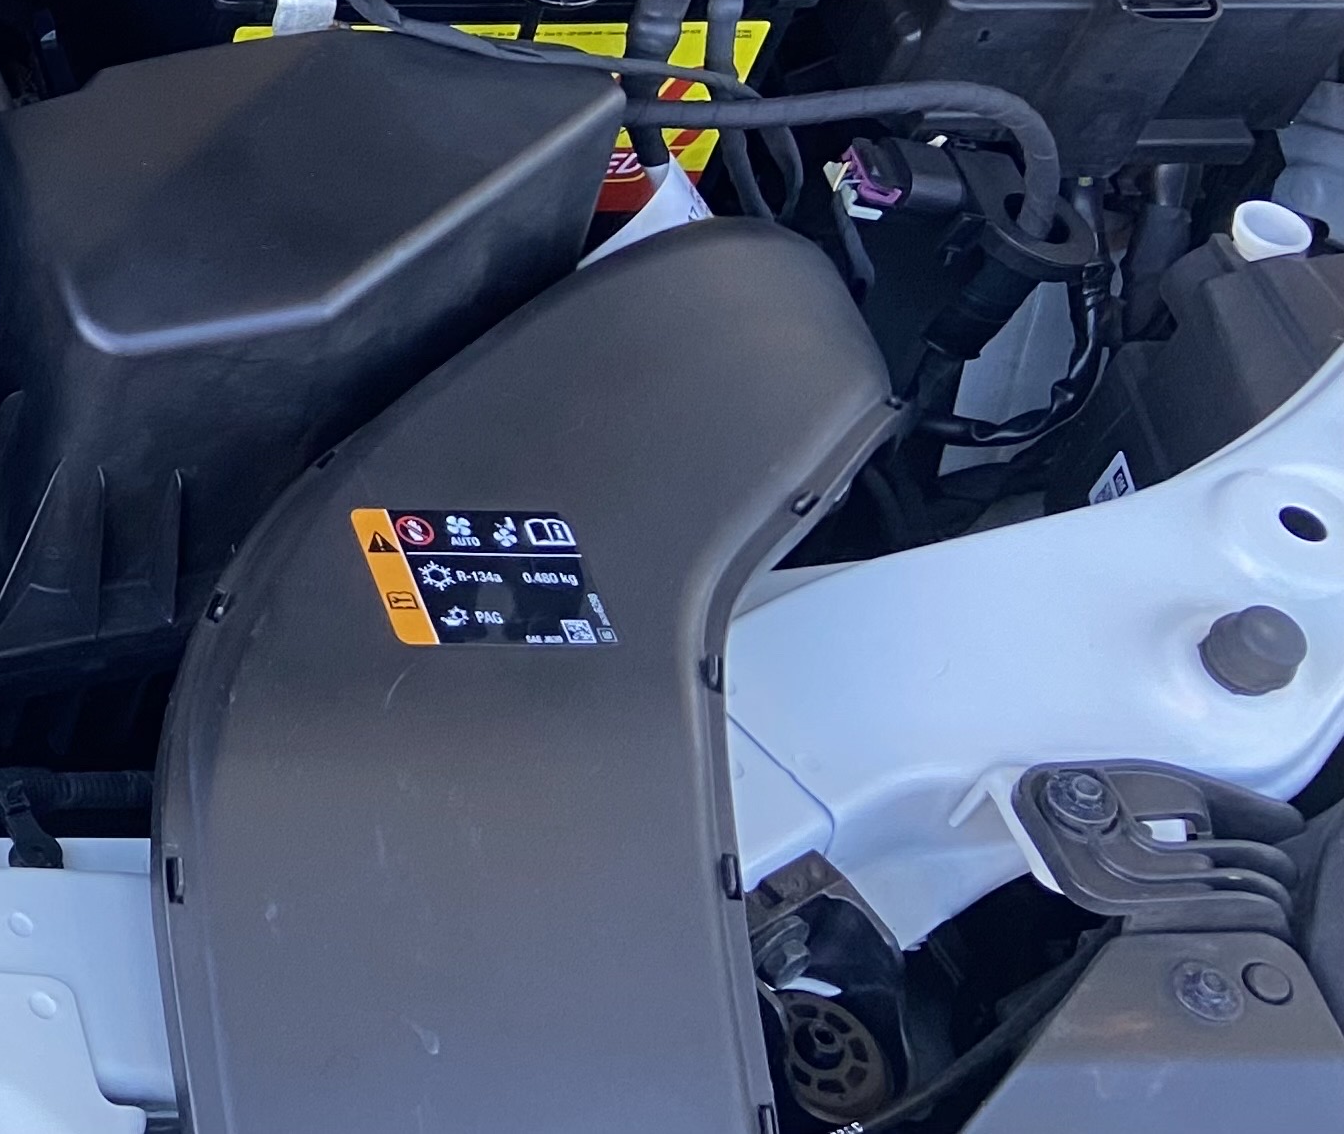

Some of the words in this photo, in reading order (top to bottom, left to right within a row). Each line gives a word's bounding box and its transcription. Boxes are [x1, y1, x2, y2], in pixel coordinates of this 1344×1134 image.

[450, 536, 481, 547] AUTO
[456, 570, 503, 584] R-134a
[522, 571, 558, 584] 0.480
[561, 572, 579, 586] kg
[475, 610, 504, 625] PAG
